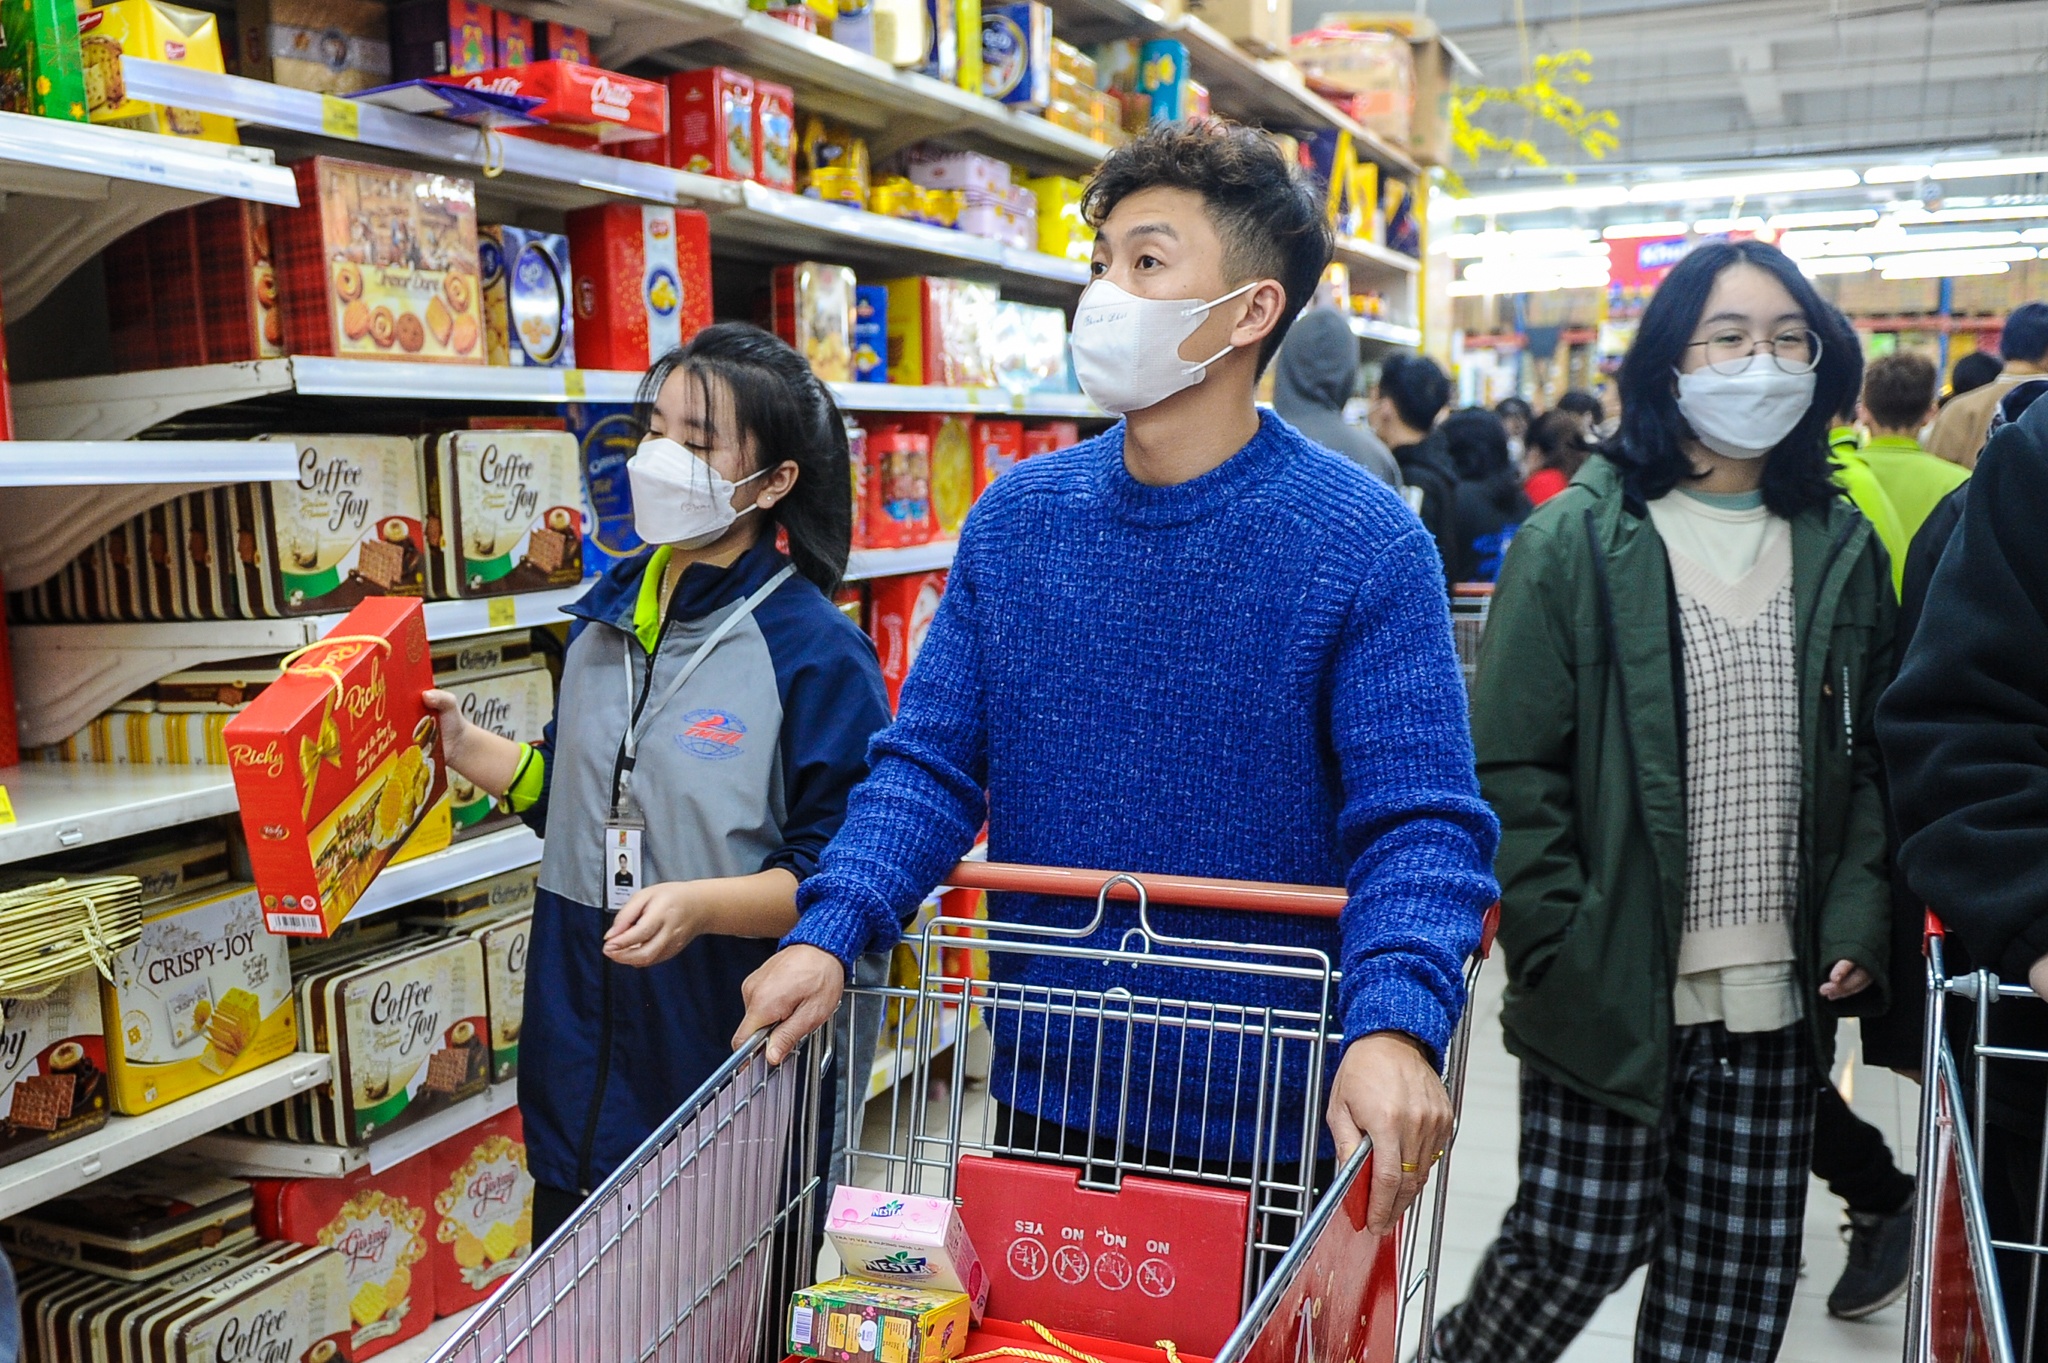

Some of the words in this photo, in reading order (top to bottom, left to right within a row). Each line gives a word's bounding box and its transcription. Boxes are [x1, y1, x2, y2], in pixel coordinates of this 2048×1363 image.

[297, 447, 361, 495] Coffee
[480, 444, 533, 488] Coffee
[328, 490, 368, 531] Joy
[504, 483, 540, 521] Joy
[343, 655, 386, 731] Richy
[229, 740, 284, 778] Richy
[148, 930, 255, 985] CRISPY-JOY
[371, 981, 432, 1025] Coffee
[399, 1009, 438, 1056] Joy
[468, 1164, 518, 1218] Giving
[872, 1206, 903, 1217] NESTEA
[1014, 1220, 1045, 1236] YES
[1061, 1227, 1084, 1240] NO
[1103, 1233, 1127, 1248] NO
[1146, 1240, 1170, 1254] NO
[866, 1260, 932, 1274] NESTEA
[216, 1309, 287, 1363] Coffee
